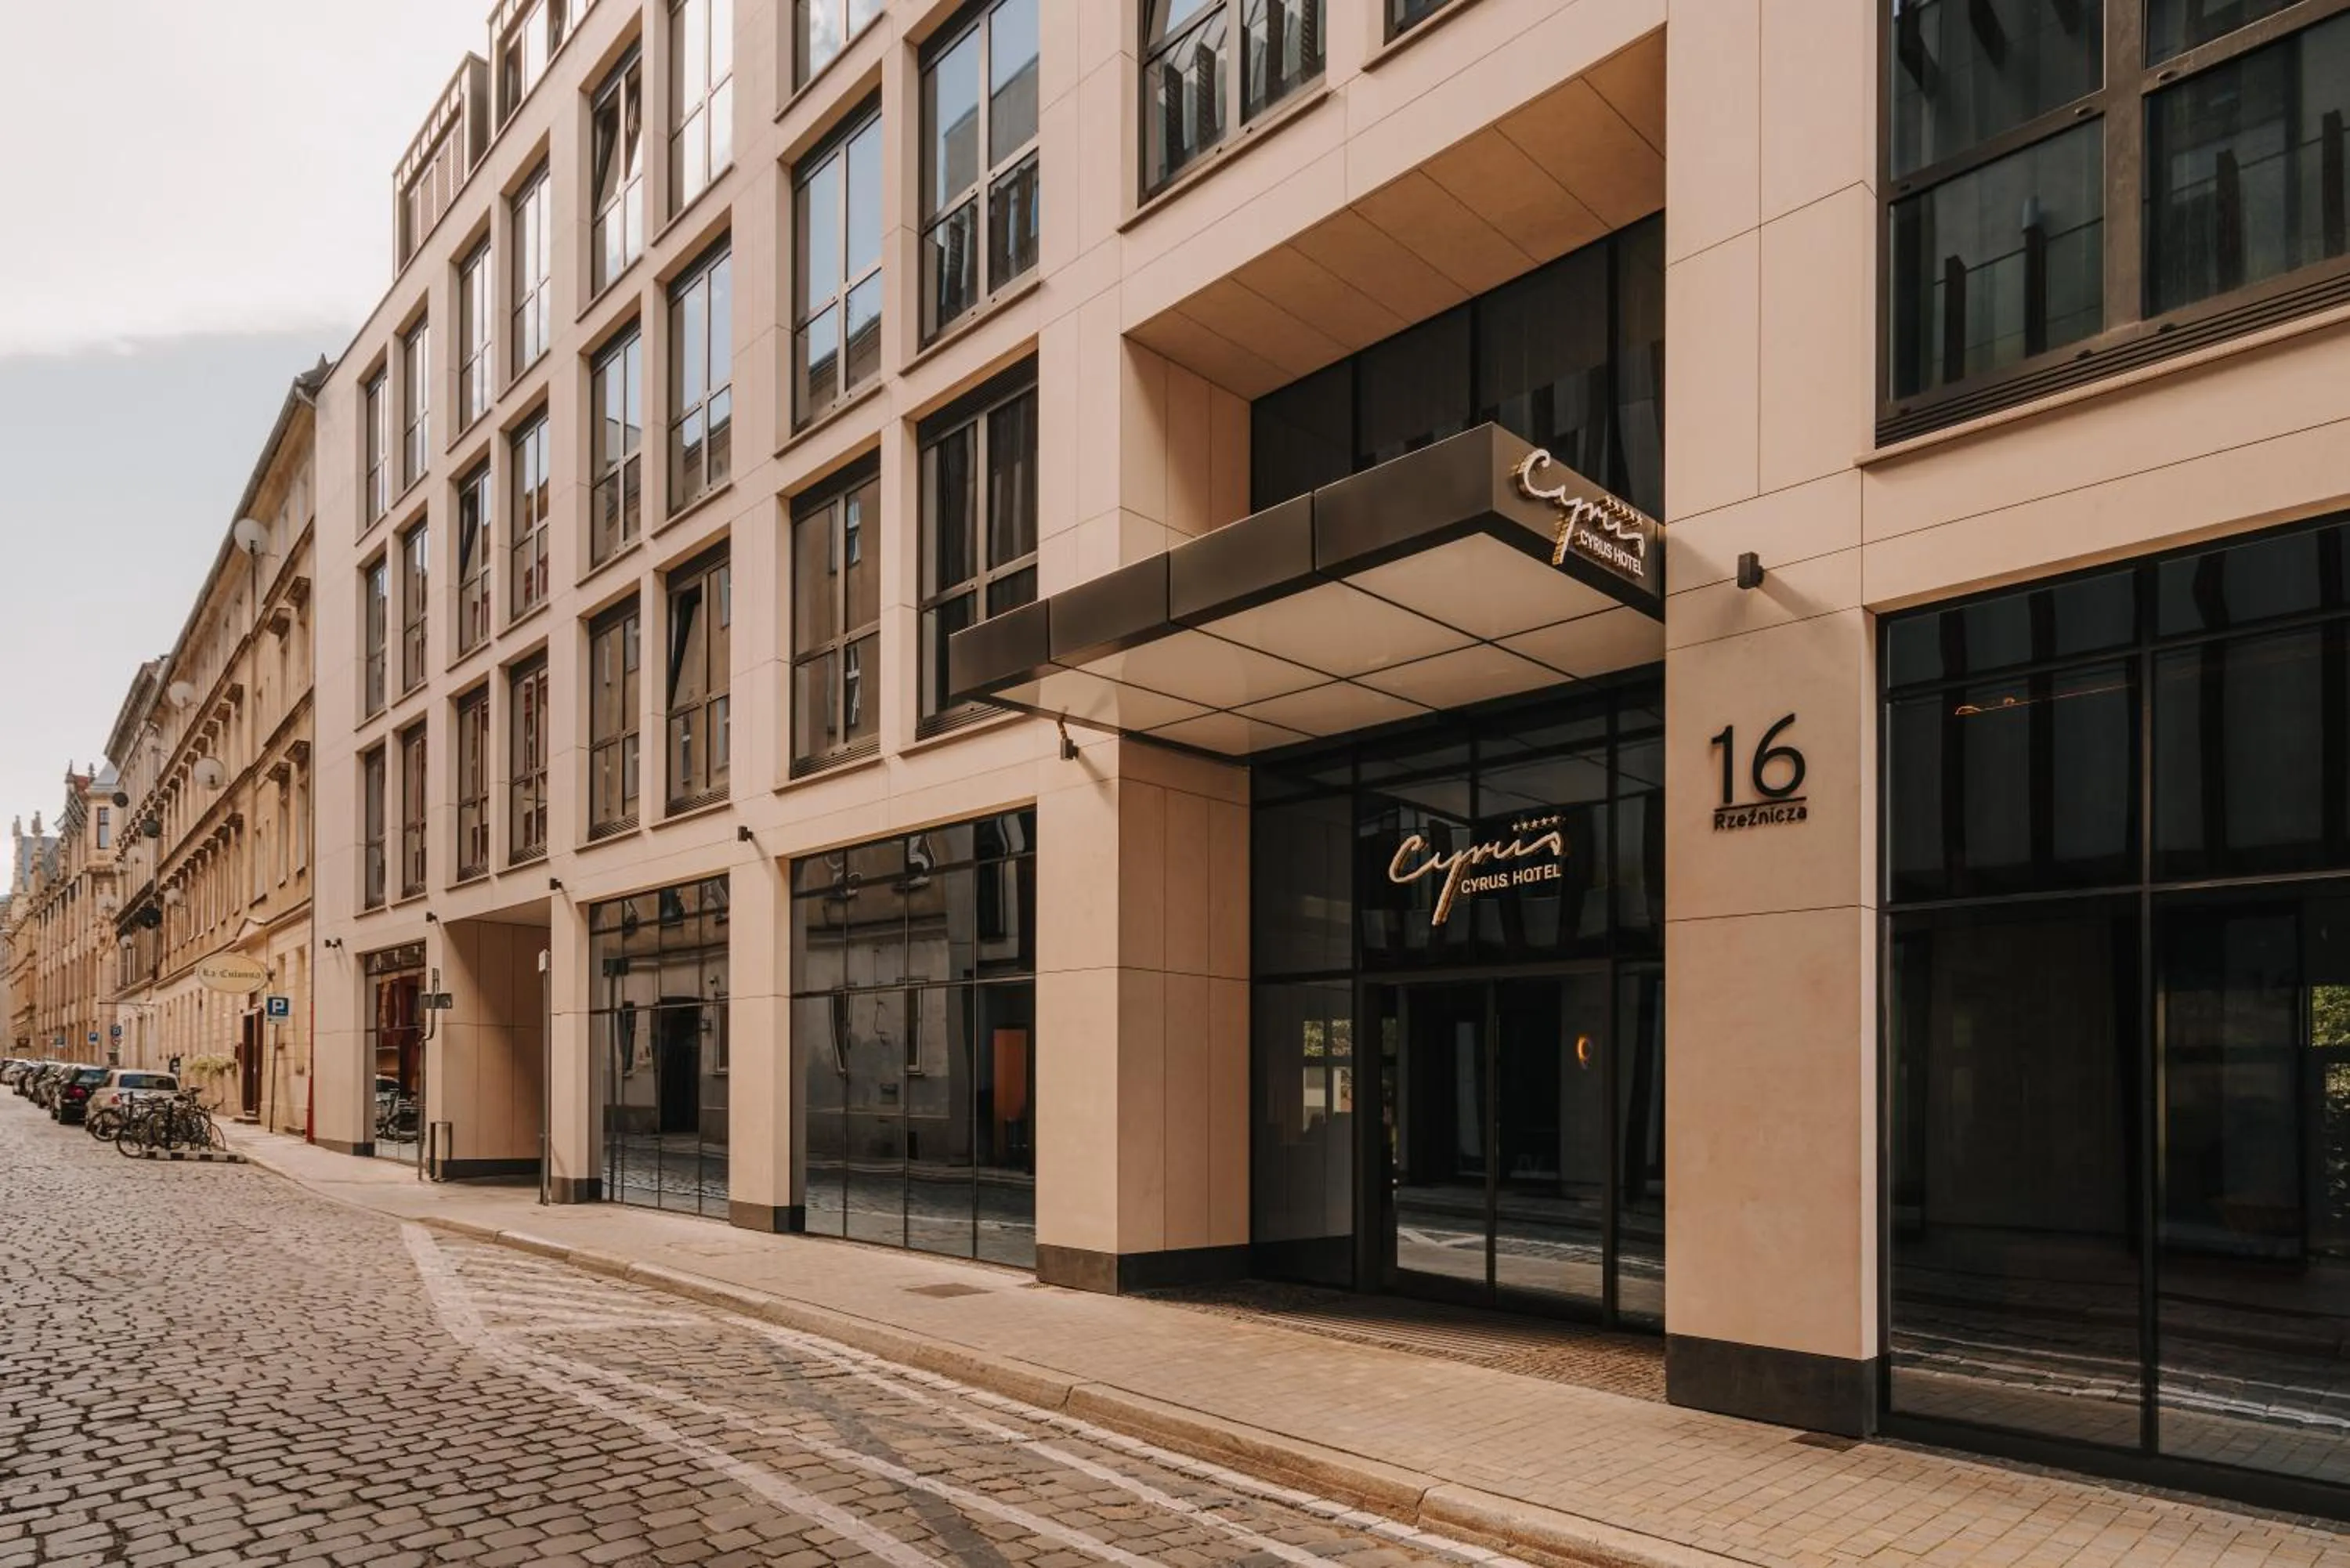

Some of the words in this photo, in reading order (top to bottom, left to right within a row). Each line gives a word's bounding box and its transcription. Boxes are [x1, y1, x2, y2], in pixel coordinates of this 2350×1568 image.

[1579, 529, 1612, 558] CYRUS
[1614, 546, 1643, 576] HOTEL
[1711, 712, 1806, 804] 16
[1713, 805, 1807, 832] Rzeźnicza
[1388, 830, 1564, 927] Cyrus
[1461, 873, 1508, 894] CYRUS
[1513, 864, 1561, 885] HOTEL
[272, 999, 285, 1013] P
